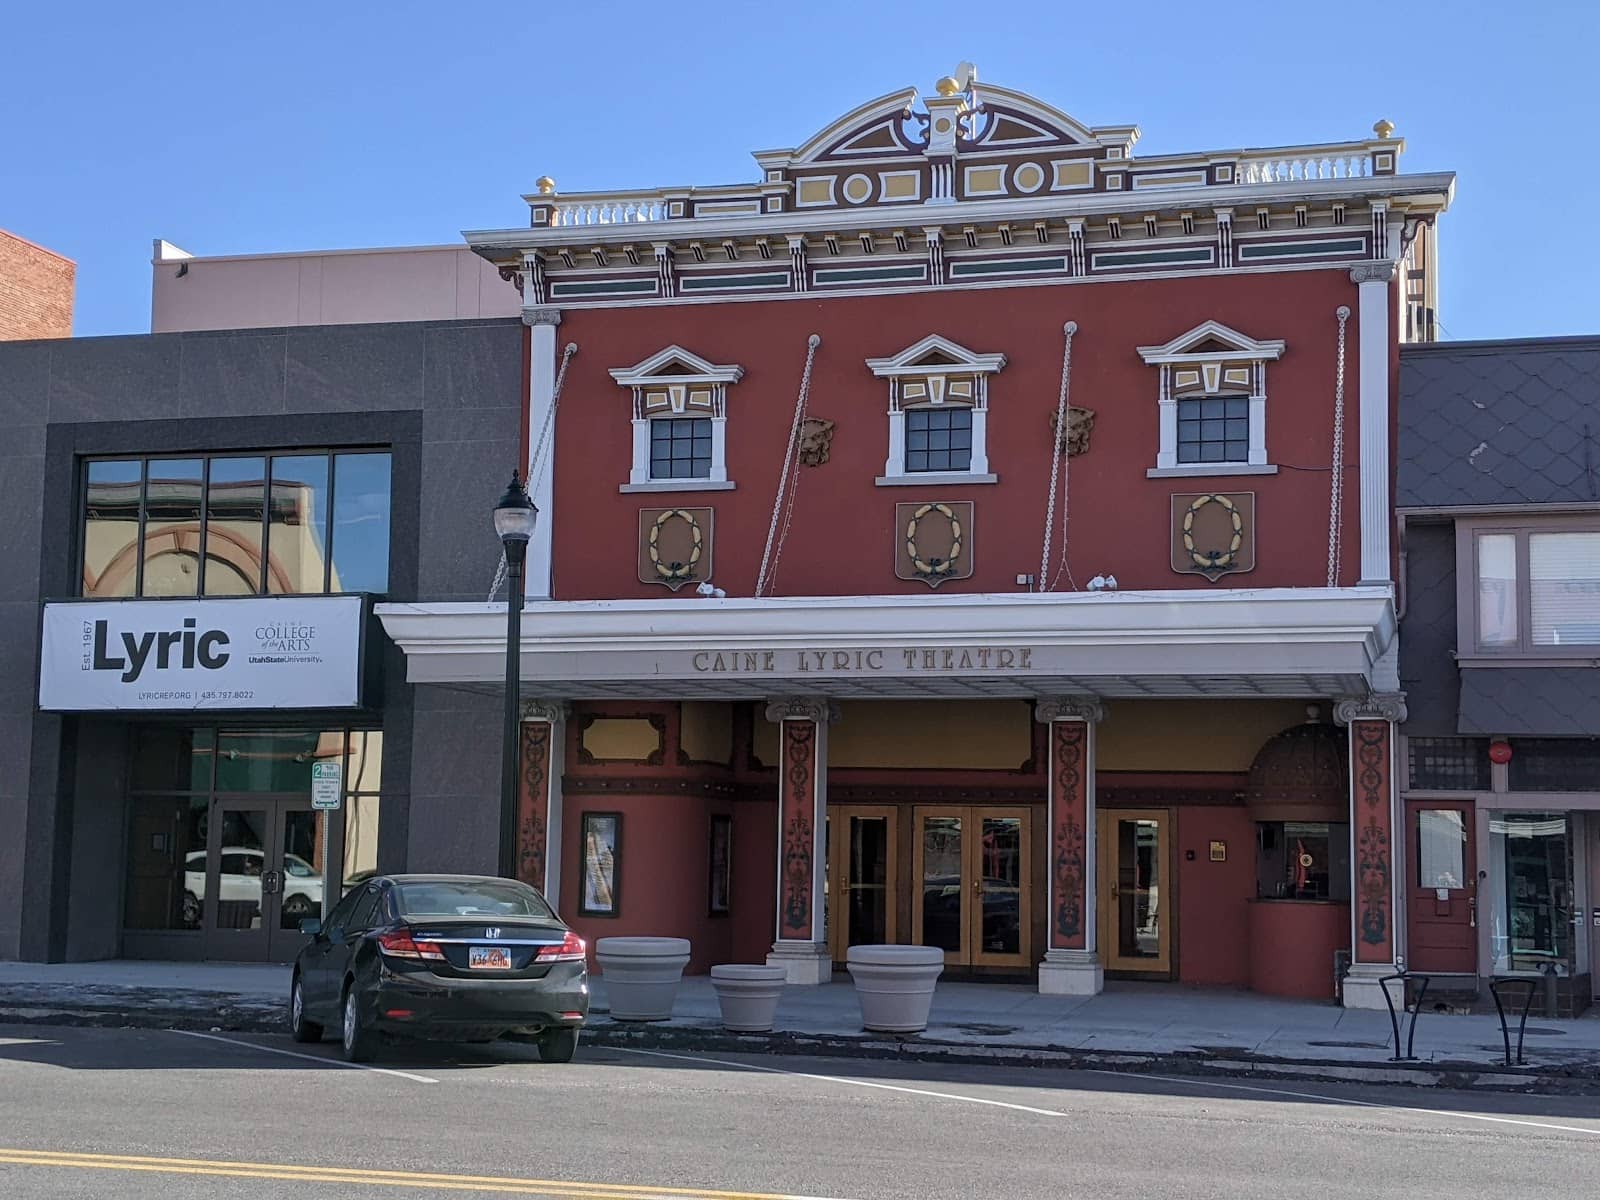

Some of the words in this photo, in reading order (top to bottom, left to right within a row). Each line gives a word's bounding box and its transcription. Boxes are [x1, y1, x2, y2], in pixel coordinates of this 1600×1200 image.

[83, 621, 92, 648] 1967
[255, 626, 316, 639] COLLEGE
[93, 618, 230, 683] Lyric
[278, 639, 310, 651] ARTS
[692, 651, 775, 672] CAINE
[797, 650, 883, 671] LYRIC
[904, 648, 1032, 670] THEATRE
[314, 765, 321, 777] 2
